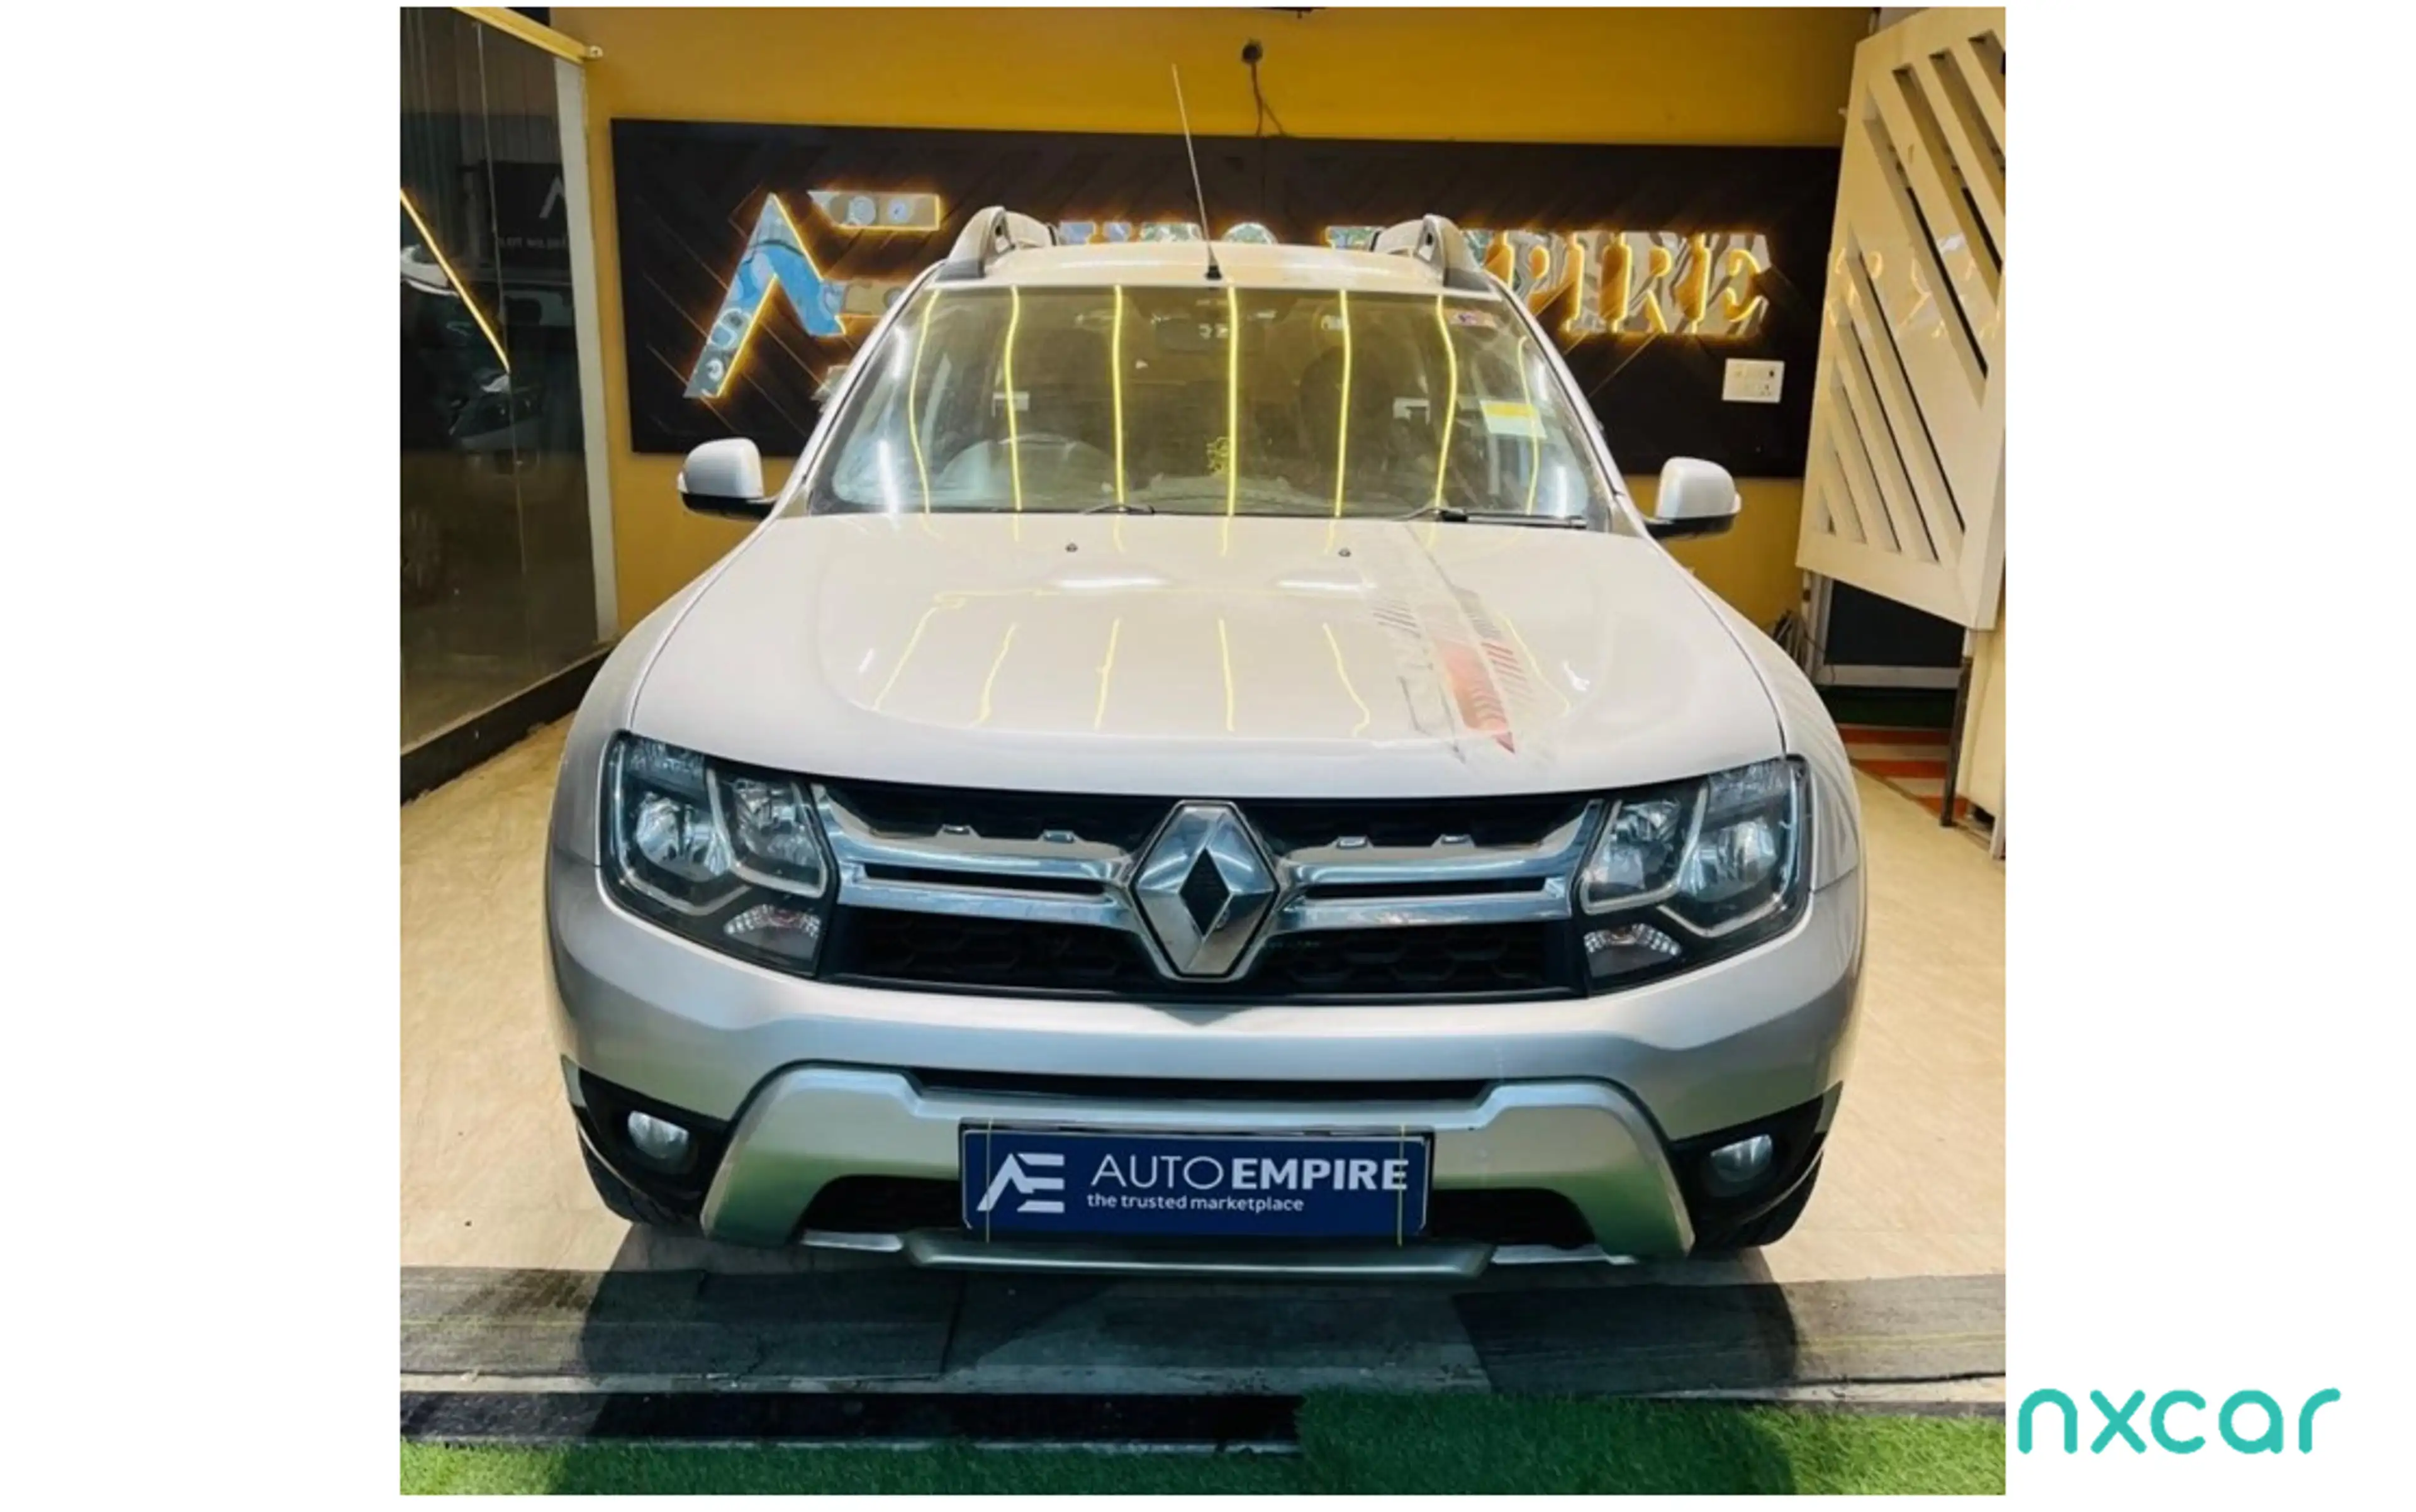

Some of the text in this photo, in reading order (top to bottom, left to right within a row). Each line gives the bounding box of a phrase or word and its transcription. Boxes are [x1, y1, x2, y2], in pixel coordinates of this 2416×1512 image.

[1325, 225, 1769, 335] PIRE
[1090, 1153, 1409, 1190] AUTO EMPIRE
[1087, 1193, 1304, 1214] the trusted marketplace
